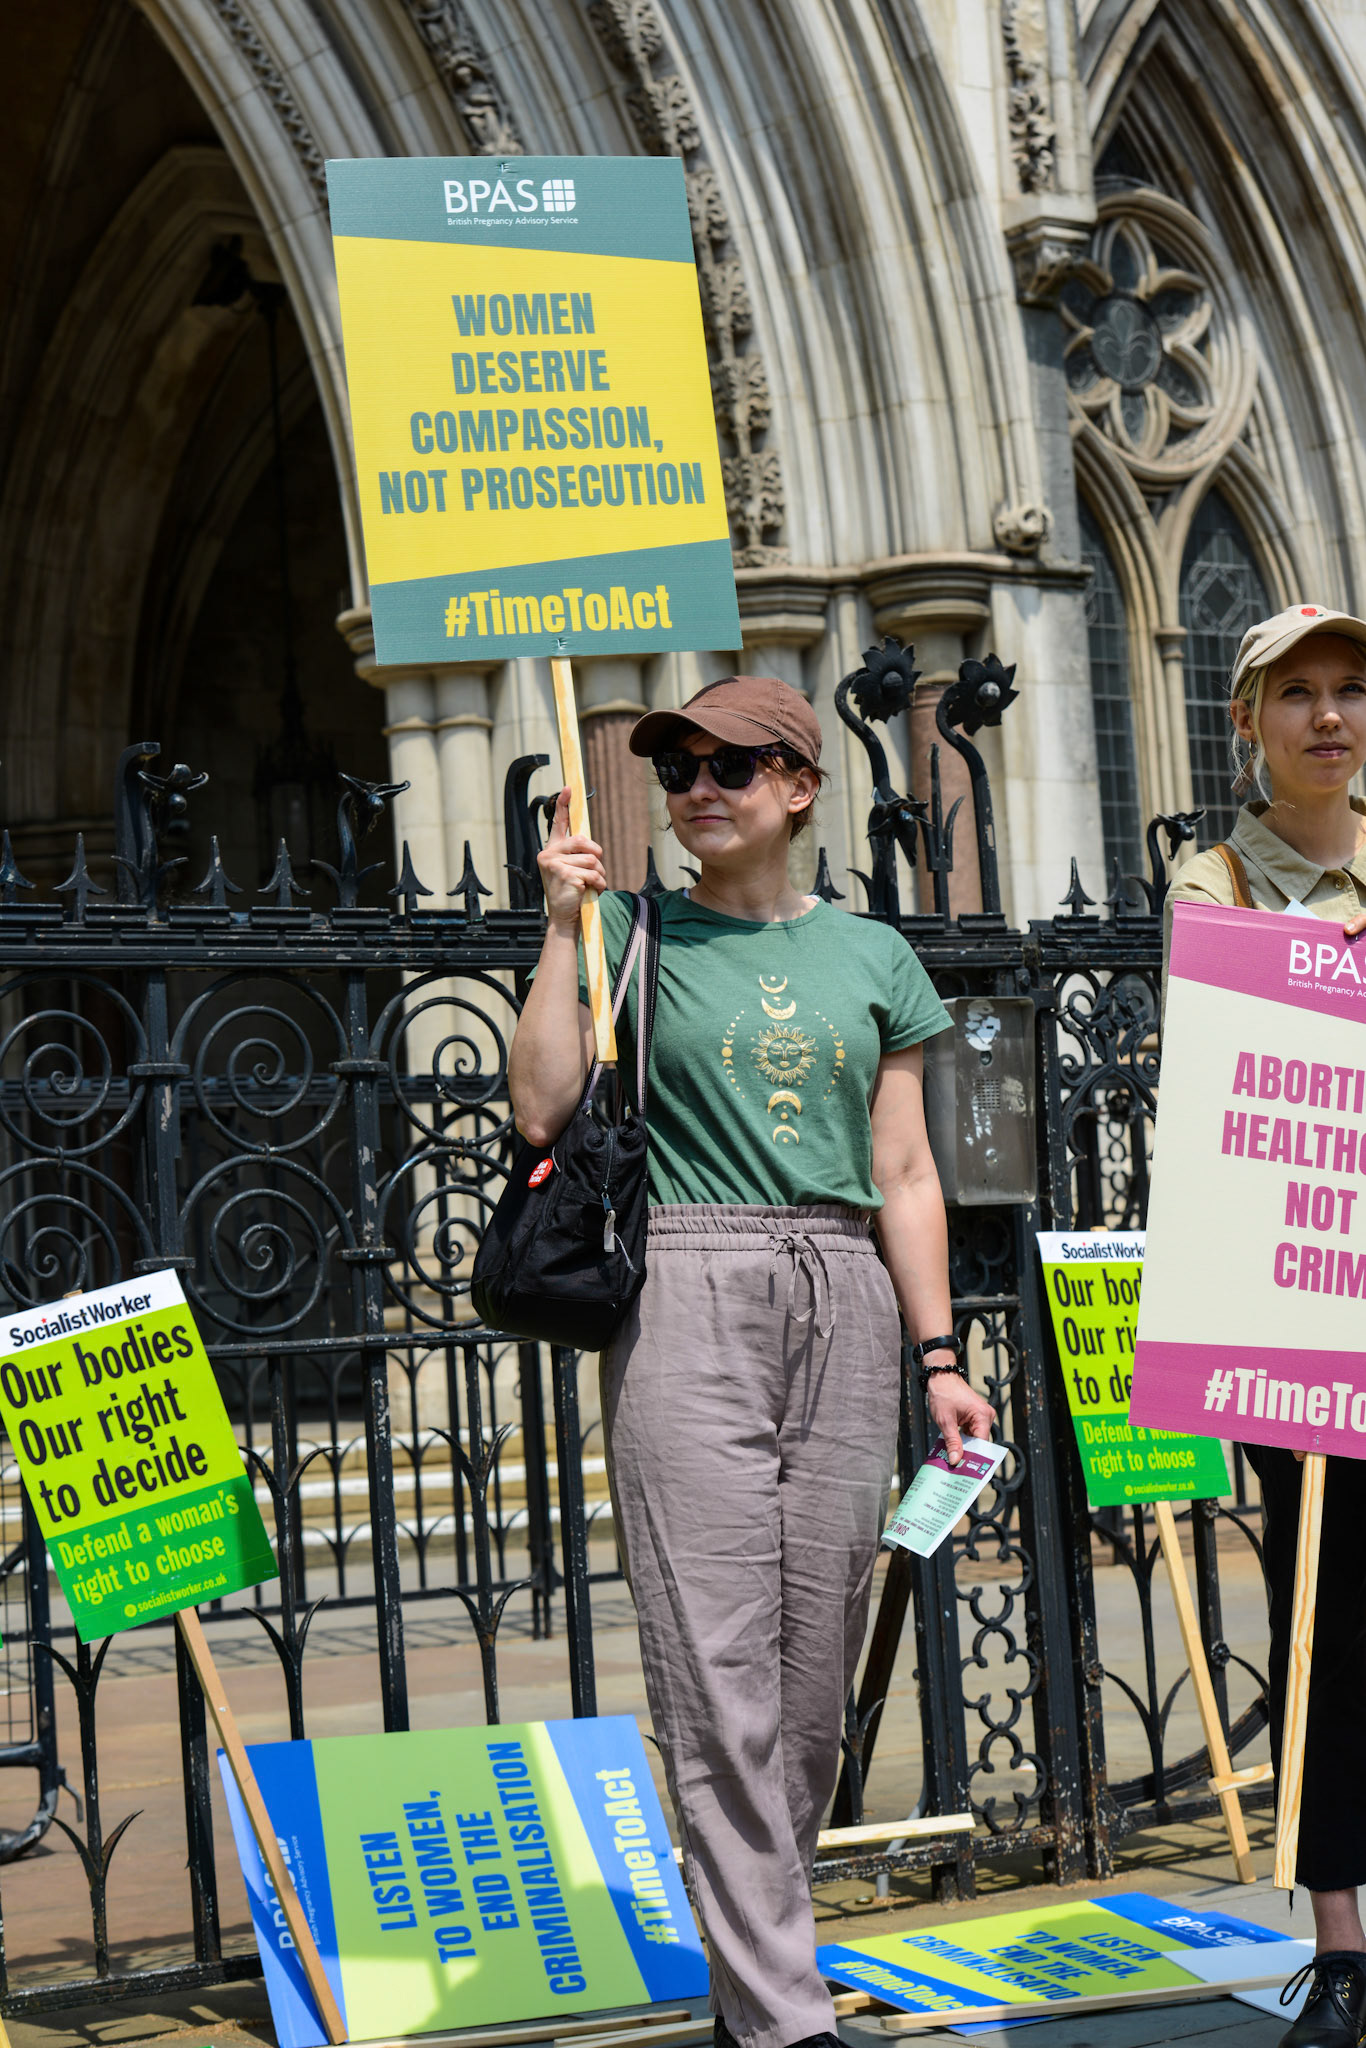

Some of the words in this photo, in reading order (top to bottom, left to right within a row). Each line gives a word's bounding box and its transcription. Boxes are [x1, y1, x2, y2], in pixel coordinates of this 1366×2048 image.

[443, 179, 539, 214] BPAS
[447, 216, 472, 225] British
[474, 217, 513, 227] Pregnancy
[515, 216, 549, 227] Advisory
[550, 216, 579, 224] Service
[451, 292, 596, 337] WOMEN
[451, 349, 610, 395] DESERVE
[409, 405, 663, 455] COMPASSION,
[378, 469, 448, 515] NOT
[461, 462, 706, 512] PROSECUTION
[444, 585, 672, 637] #TimeToAct
[1288, 939, 1366, 985] BPA
[1287, 977, 1313, 989] British
[1314, 982, 1355, 998] Pregnancy
[1284, 1181, 1358, 1235] NOT
[1053, 1268, 1094, 1308] Our
[1273, 1241, 1366, 1300] CRIM
[1062, 1316, 1105, 1357] Our
[0, 1361, 63, 1409] Our
[72, 1323, 193, 1388] bodies
[1073, 1368, 1101, 1406] to
[19, 1417, 84, 1466] Our
[97, 1378, 187, 1444] right
[1203, 1367, 1366, 1434] #TimeTo
[1082, 1418, 1134, 1445] Defend
[39, 1480, 81, 1523] to
[92, 1435, 208, 1507] decide
[1089, 1449, 1126, 1479] right
[1127, 1449, 1144, 1472] to
[1147, 1446, 1196, 1470] choose
[1133, 1479, 1196, 1495] socialistworker.co.uk
[57, 1522, 133, 1569] Defend
[137, 1522, 153, 1544] a
[155, 1490, 239, 1537] woman's
[72, 1565, 123, 1606] right
[125, 1560, 150, 1585] to
[156, 1536, 226, 1575] choose
[137, 1572, 228, 1613] socialistworker.co.uk
[402, 1790, 466, 1918] WOMEN,
[456, 1811, 502, 1866] THE
[595, 1767, 680, 1945] #TimeToAct
[359, 1832, 418, 1932] LISTEN
[486, 1742, 587, 1995] CRIMINALISATION
[472, 1874, 520, 1932] END
[1161, 1915, 1233, 1940] BPAS
[434, 1926, 477, 1964] TO
[1015, 1930, 1060, 1945] TO
[1079, 1932, 1164, 1961] LISTEN
[829, 1961, 979, 2010] #TimeToAc
[902, 1935, 1086, 2000] CRIMINALISATIO
[988, 1945, 1049, 1964] END
[1033, 1961, 1093, 1981] THE
